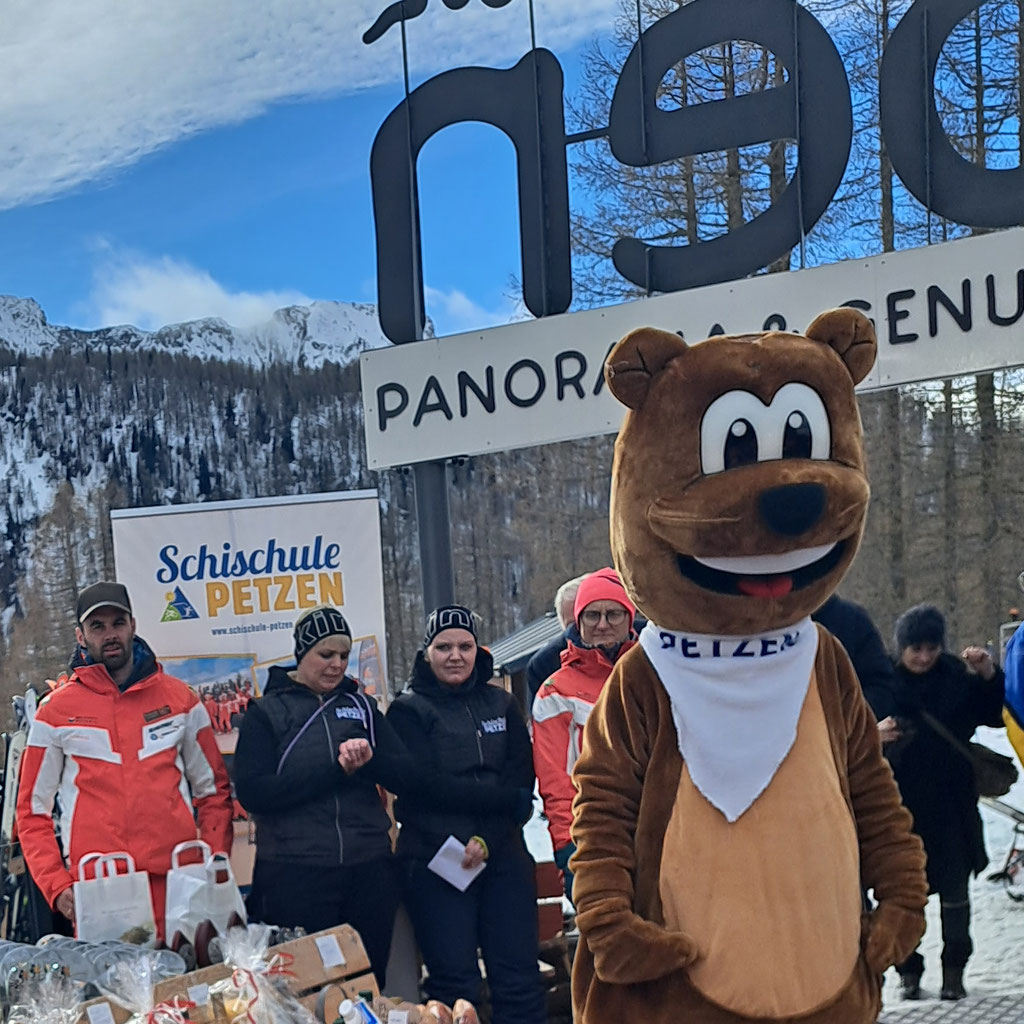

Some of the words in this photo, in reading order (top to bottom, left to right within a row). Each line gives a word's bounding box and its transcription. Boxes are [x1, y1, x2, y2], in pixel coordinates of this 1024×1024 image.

[378, 323, 726, 432] PANOR
[838, 268, 1024, 345] ENU
[156, 535, 341, 583] Schischule
[206, 572, 345, 617] PETZEN
